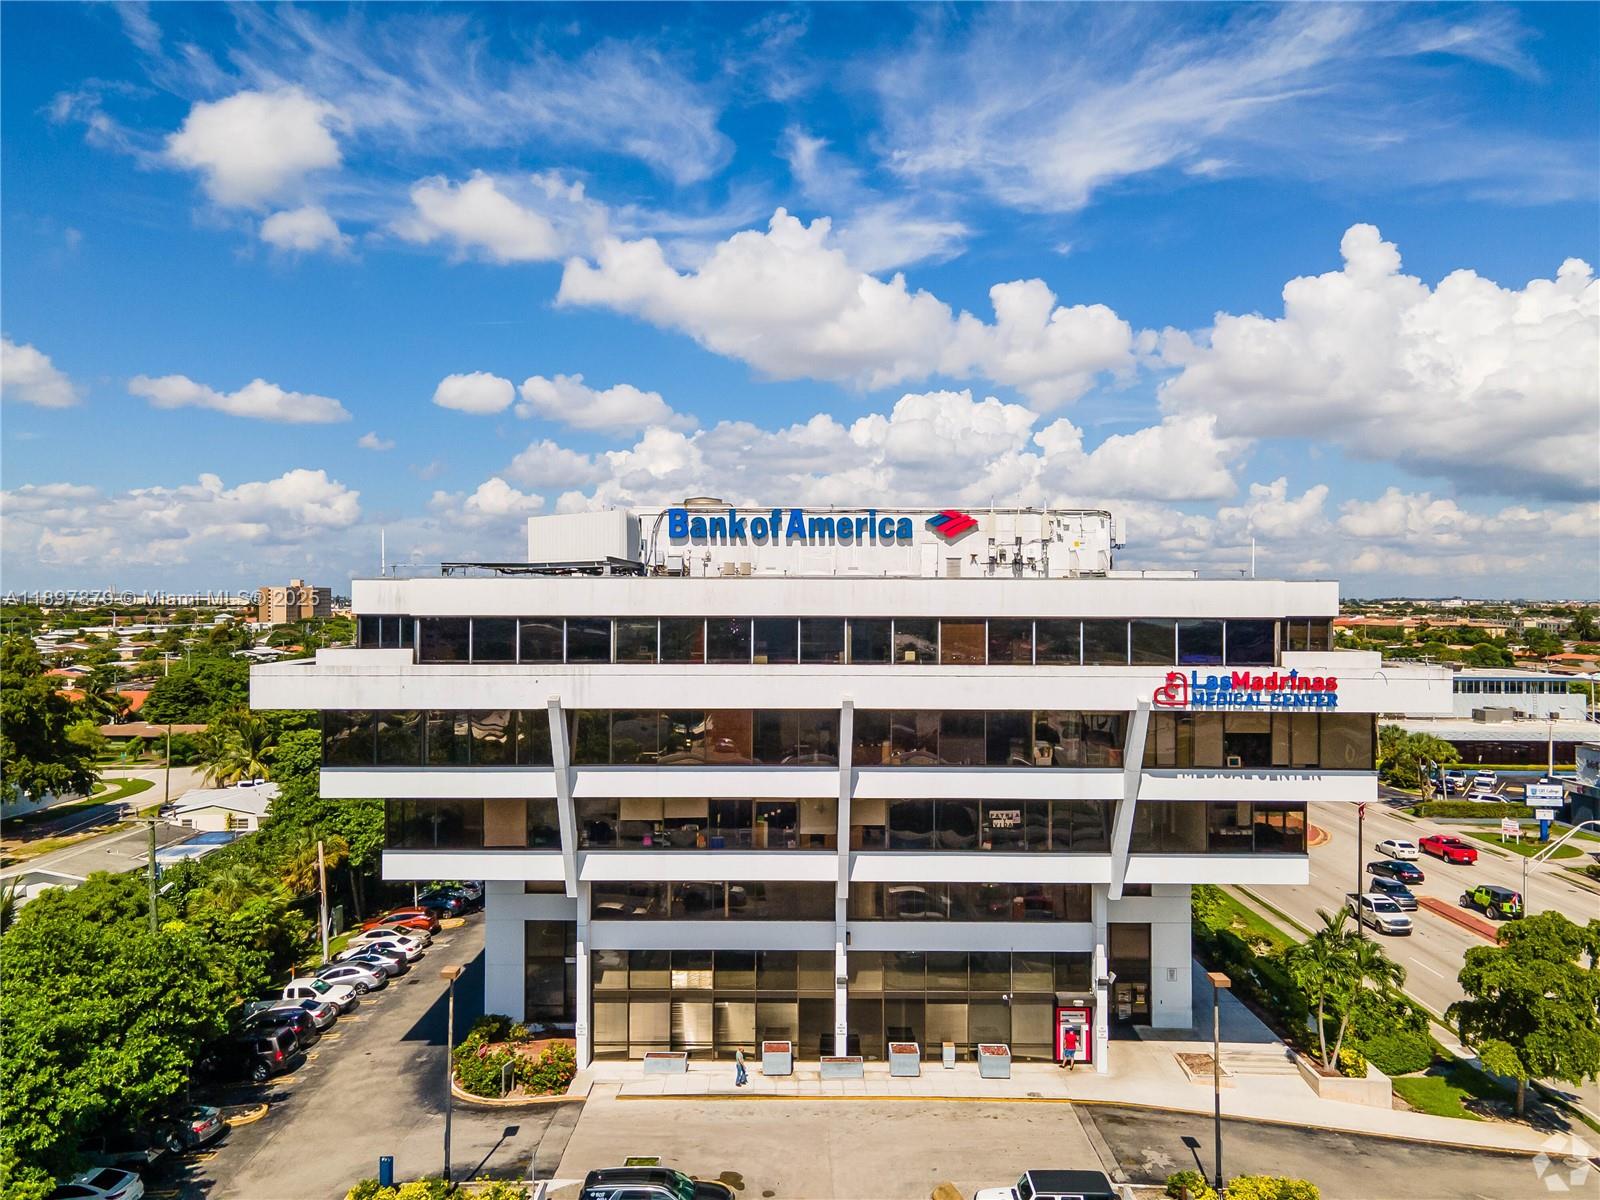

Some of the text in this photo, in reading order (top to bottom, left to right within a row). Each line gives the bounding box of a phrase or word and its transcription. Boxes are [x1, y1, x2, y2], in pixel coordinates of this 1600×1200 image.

[668, 508, 913, 539] Bank of America
[1191, 692, 1338, 707] MEDICAL CENTER
